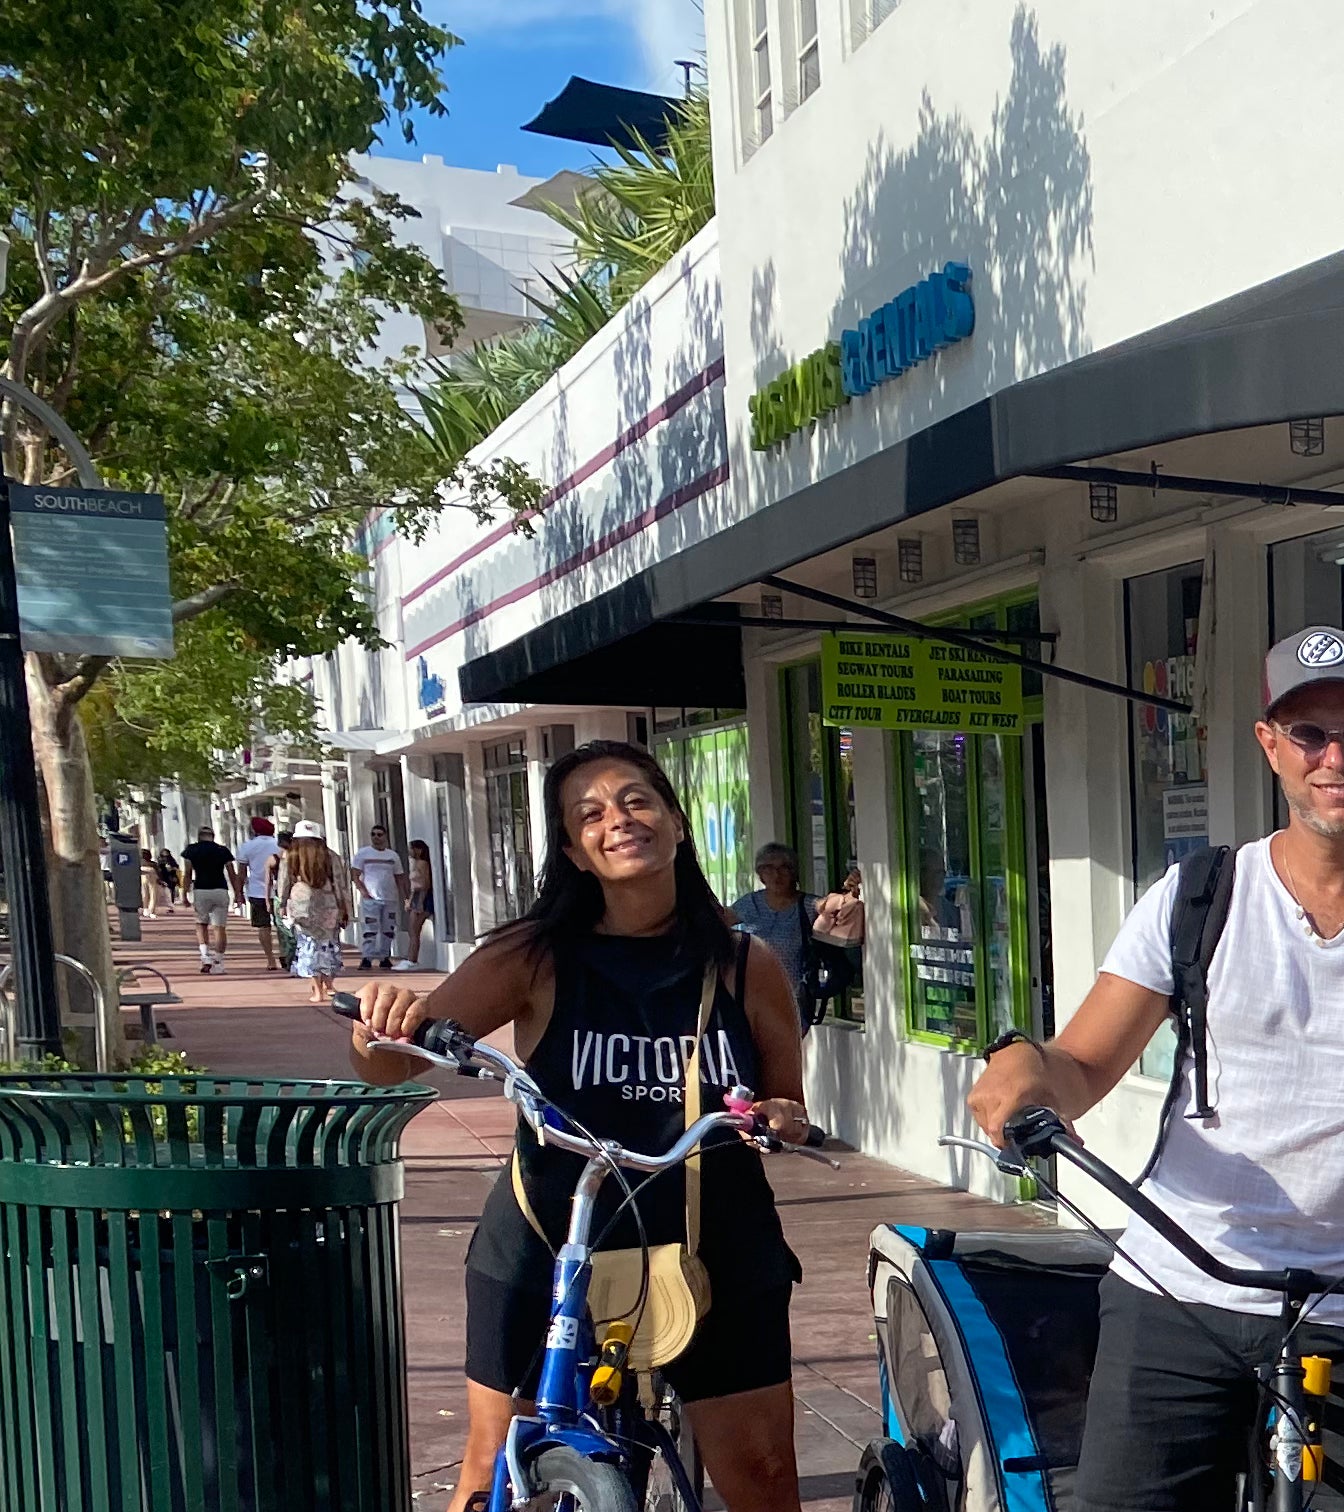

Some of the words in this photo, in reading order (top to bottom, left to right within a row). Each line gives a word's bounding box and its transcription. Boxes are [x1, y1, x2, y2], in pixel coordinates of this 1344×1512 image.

[839, 640, 863, 657] BIKE
[865, 642, 910, 659] RENTALS
[929, 646, 947, 661] JET
[949, 647, 965, 662] SKI
[838, 662, 879, 677] SEGWAY
[881, 664, 914, 679] TOURS
[938, 667, 1003, 684] PARASAILING
[837, 683, 875, 699] ROLLER
[877, 685, 916, 701] BLADES
[942, 689, 968, 704] BOAT
[969, 690, 1001, 705] TOURS
[829, 705, 853, 720] CITY
[854, 706, 882, 721] TOUR
[896, 708, 961, 725] EVERGLADES
[969, 711, 990, 727] KEY
[991, 713, 1019, 728] WEST
[571, 1029, 741, 1091] VICTORIA
[621, 1084, 687, 1103] SPOR
